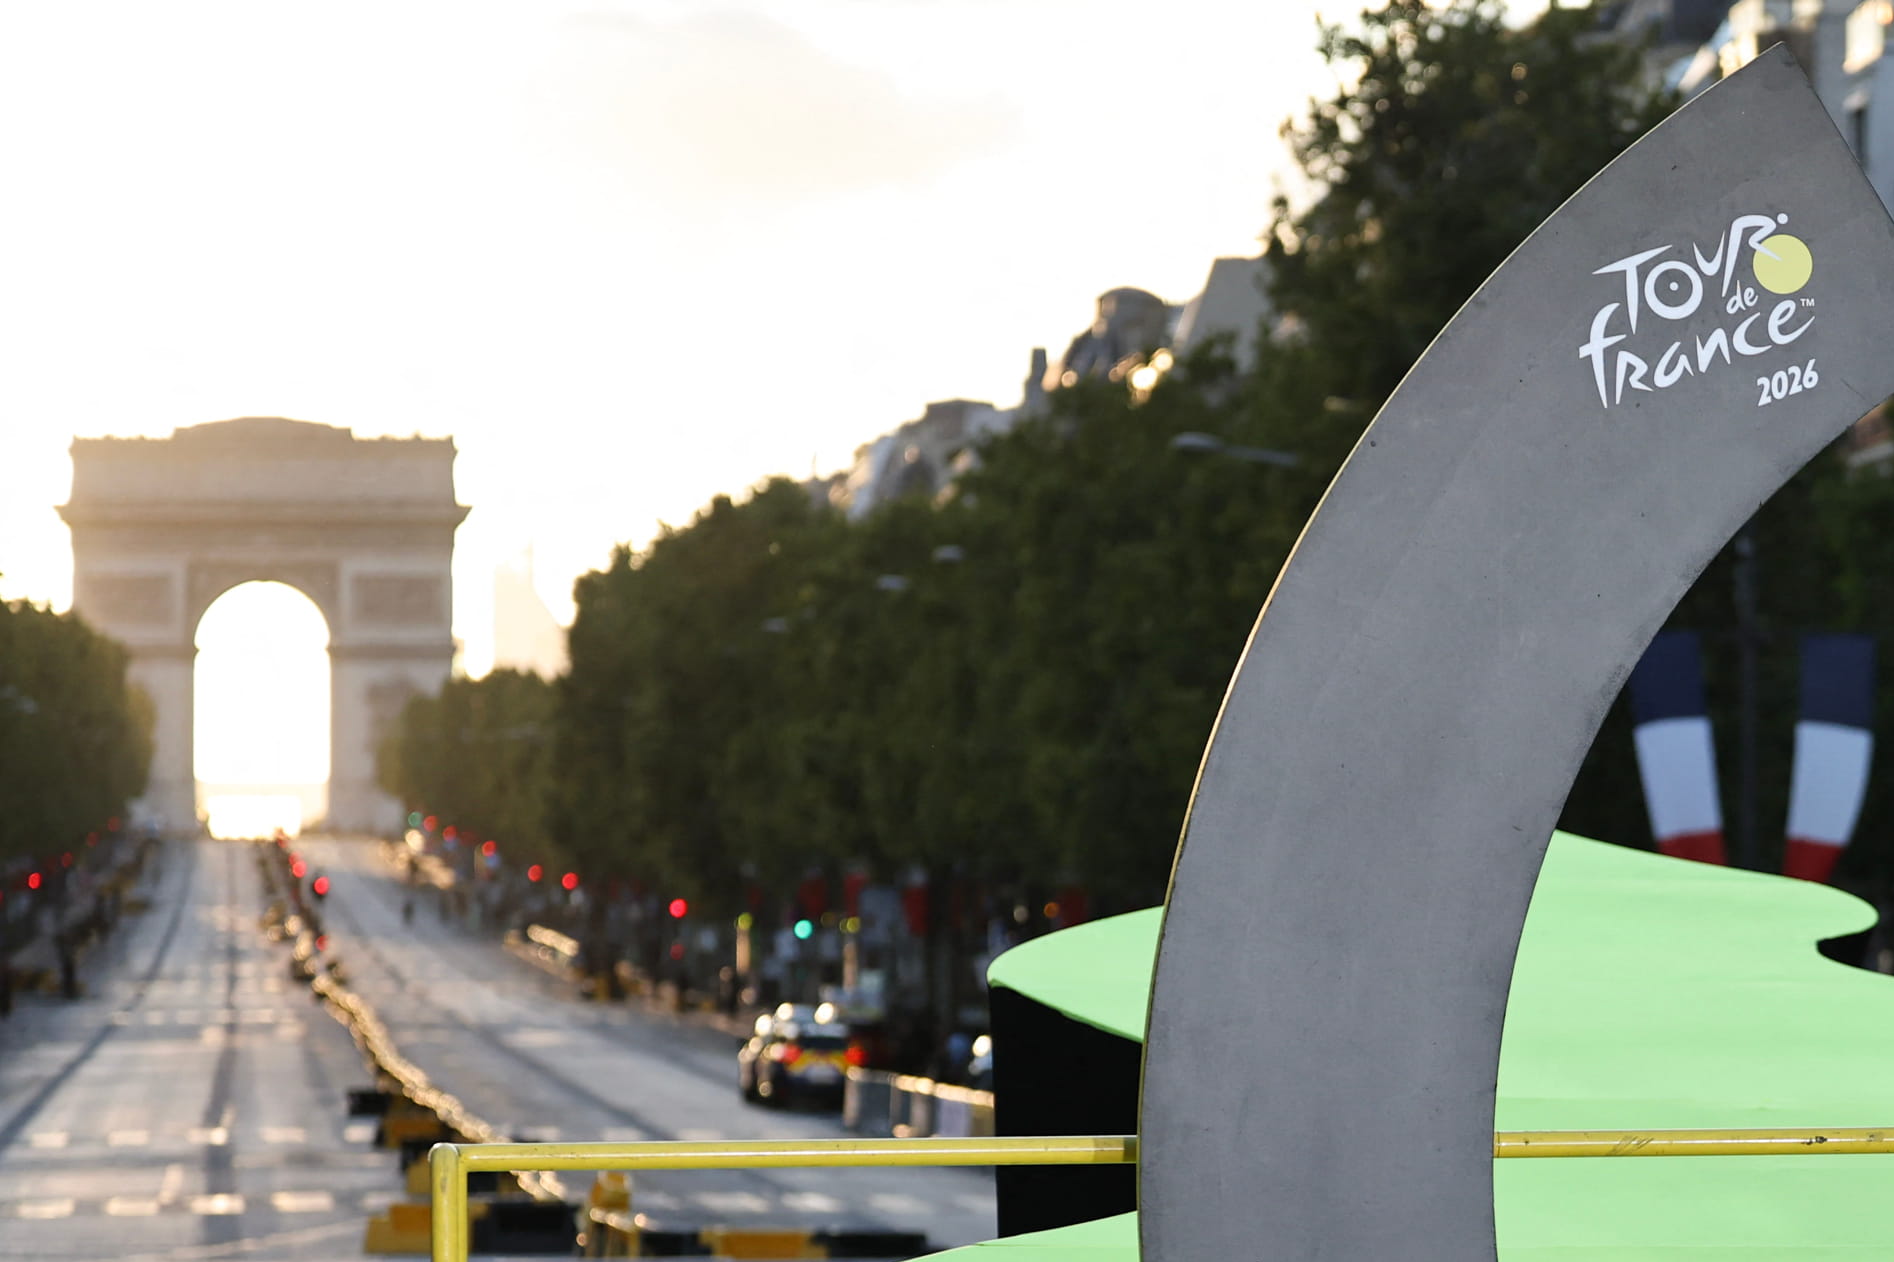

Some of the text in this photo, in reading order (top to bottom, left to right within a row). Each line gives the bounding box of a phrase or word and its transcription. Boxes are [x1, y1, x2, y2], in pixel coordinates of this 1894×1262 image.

[1592, 213, 1788, 335] TOUR
[1726, 280, 1758, 314] de
[1757, 359, 1818, 407] 2026
